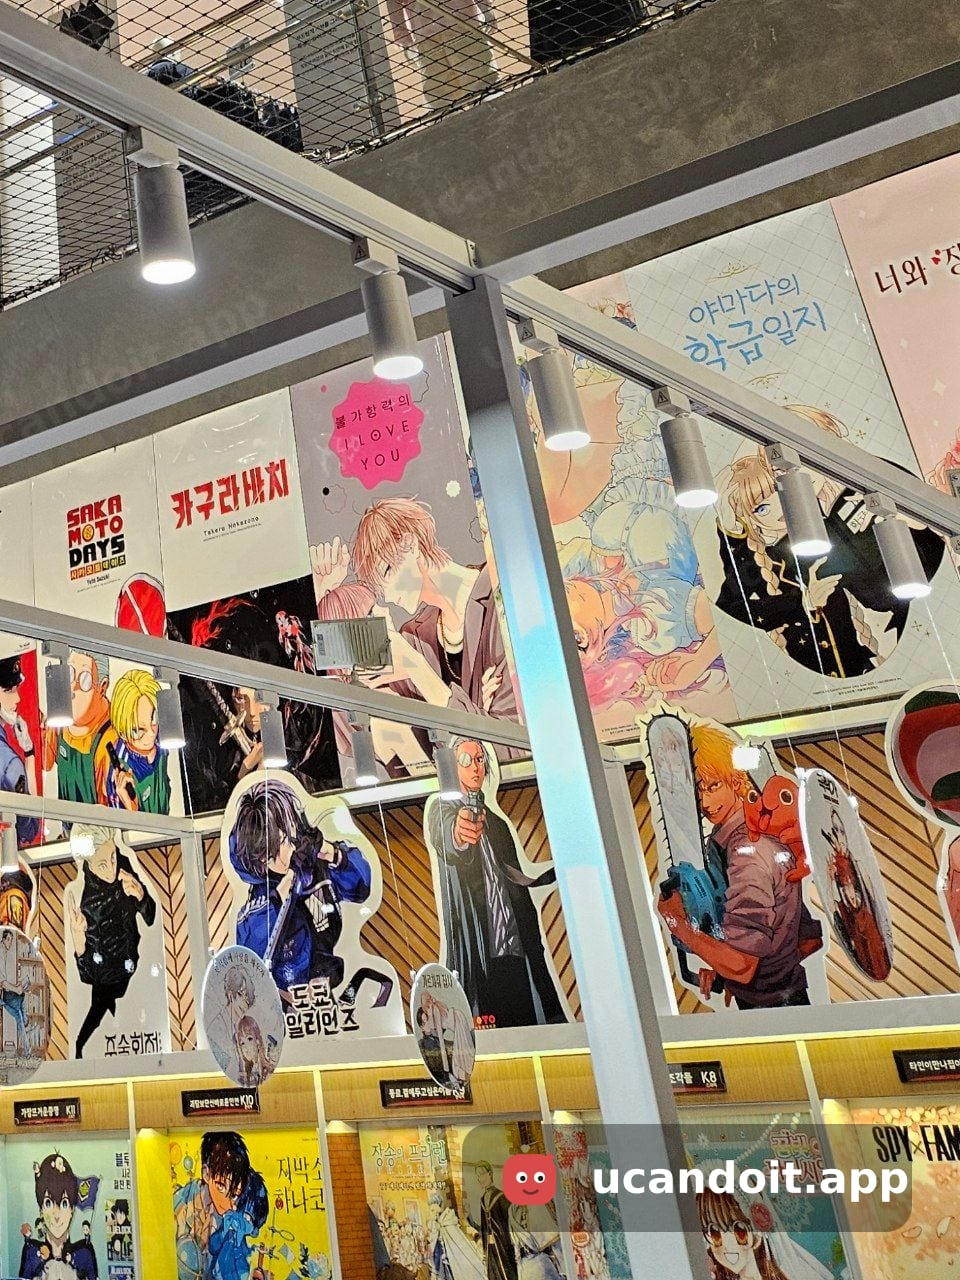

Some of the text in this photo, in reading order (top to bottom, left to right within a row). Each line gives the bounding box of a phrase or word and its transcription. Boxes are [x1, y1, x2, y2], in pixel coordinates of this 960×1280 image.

[875, 256, 928, 293] 너와
[689, 273, 800, 325] 야마다의
[683, 302, 827, 371] 학급일지
[335, 394, 410, 429] 불가항력의
[359, 420, 410, 446] LOVE
[360, 448, 400, 470] YOU
[170, 458, 290, 530] 카구라바치
[67, 494, 122, 528] SAKA
[68, 515, 123, 548] MOTO
[69, 533, 125, 568] DAYS
[292, 985, 331, 1009] 도쿄
[283, 1007, 359, 1039] 일리언즈
[701, 1069, 717, 1084] K8
[66, 1105, 76, 1116] K11
[240, 1095, 253, 1106] K10
[371, 1136, 447, 1169] 장송의 프리렌
